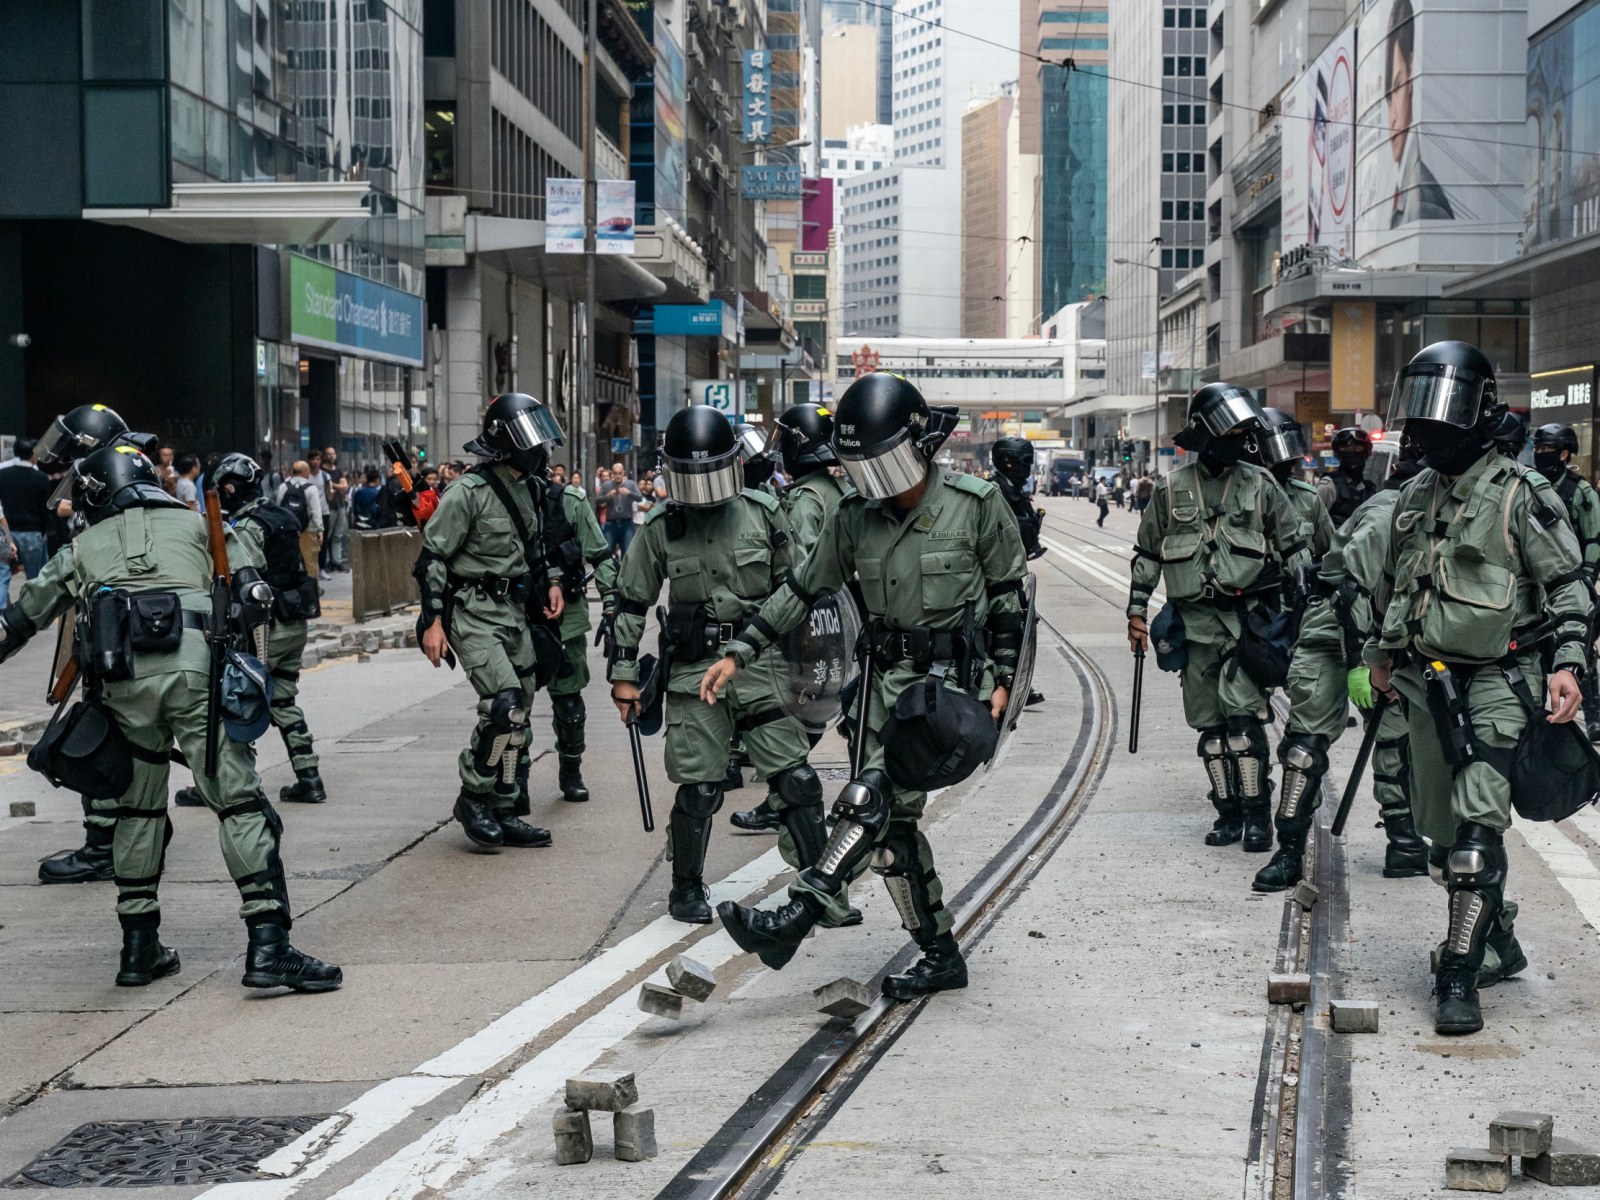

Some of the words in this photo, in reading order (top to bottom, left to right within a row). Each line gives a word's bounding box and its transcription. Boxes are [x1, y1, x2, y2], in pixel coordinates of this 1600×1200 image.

[745, 52, 769, 141] 日發文具
[305, 282, 342, 321] Standard
[344, 294, 380, 331] Chartered
[839, 437, 861, 447] Police
[840, 423, 856, 435] 警察
[810, 608, 841, 637] POLICE
[812, 657, 843, 686] 警察
